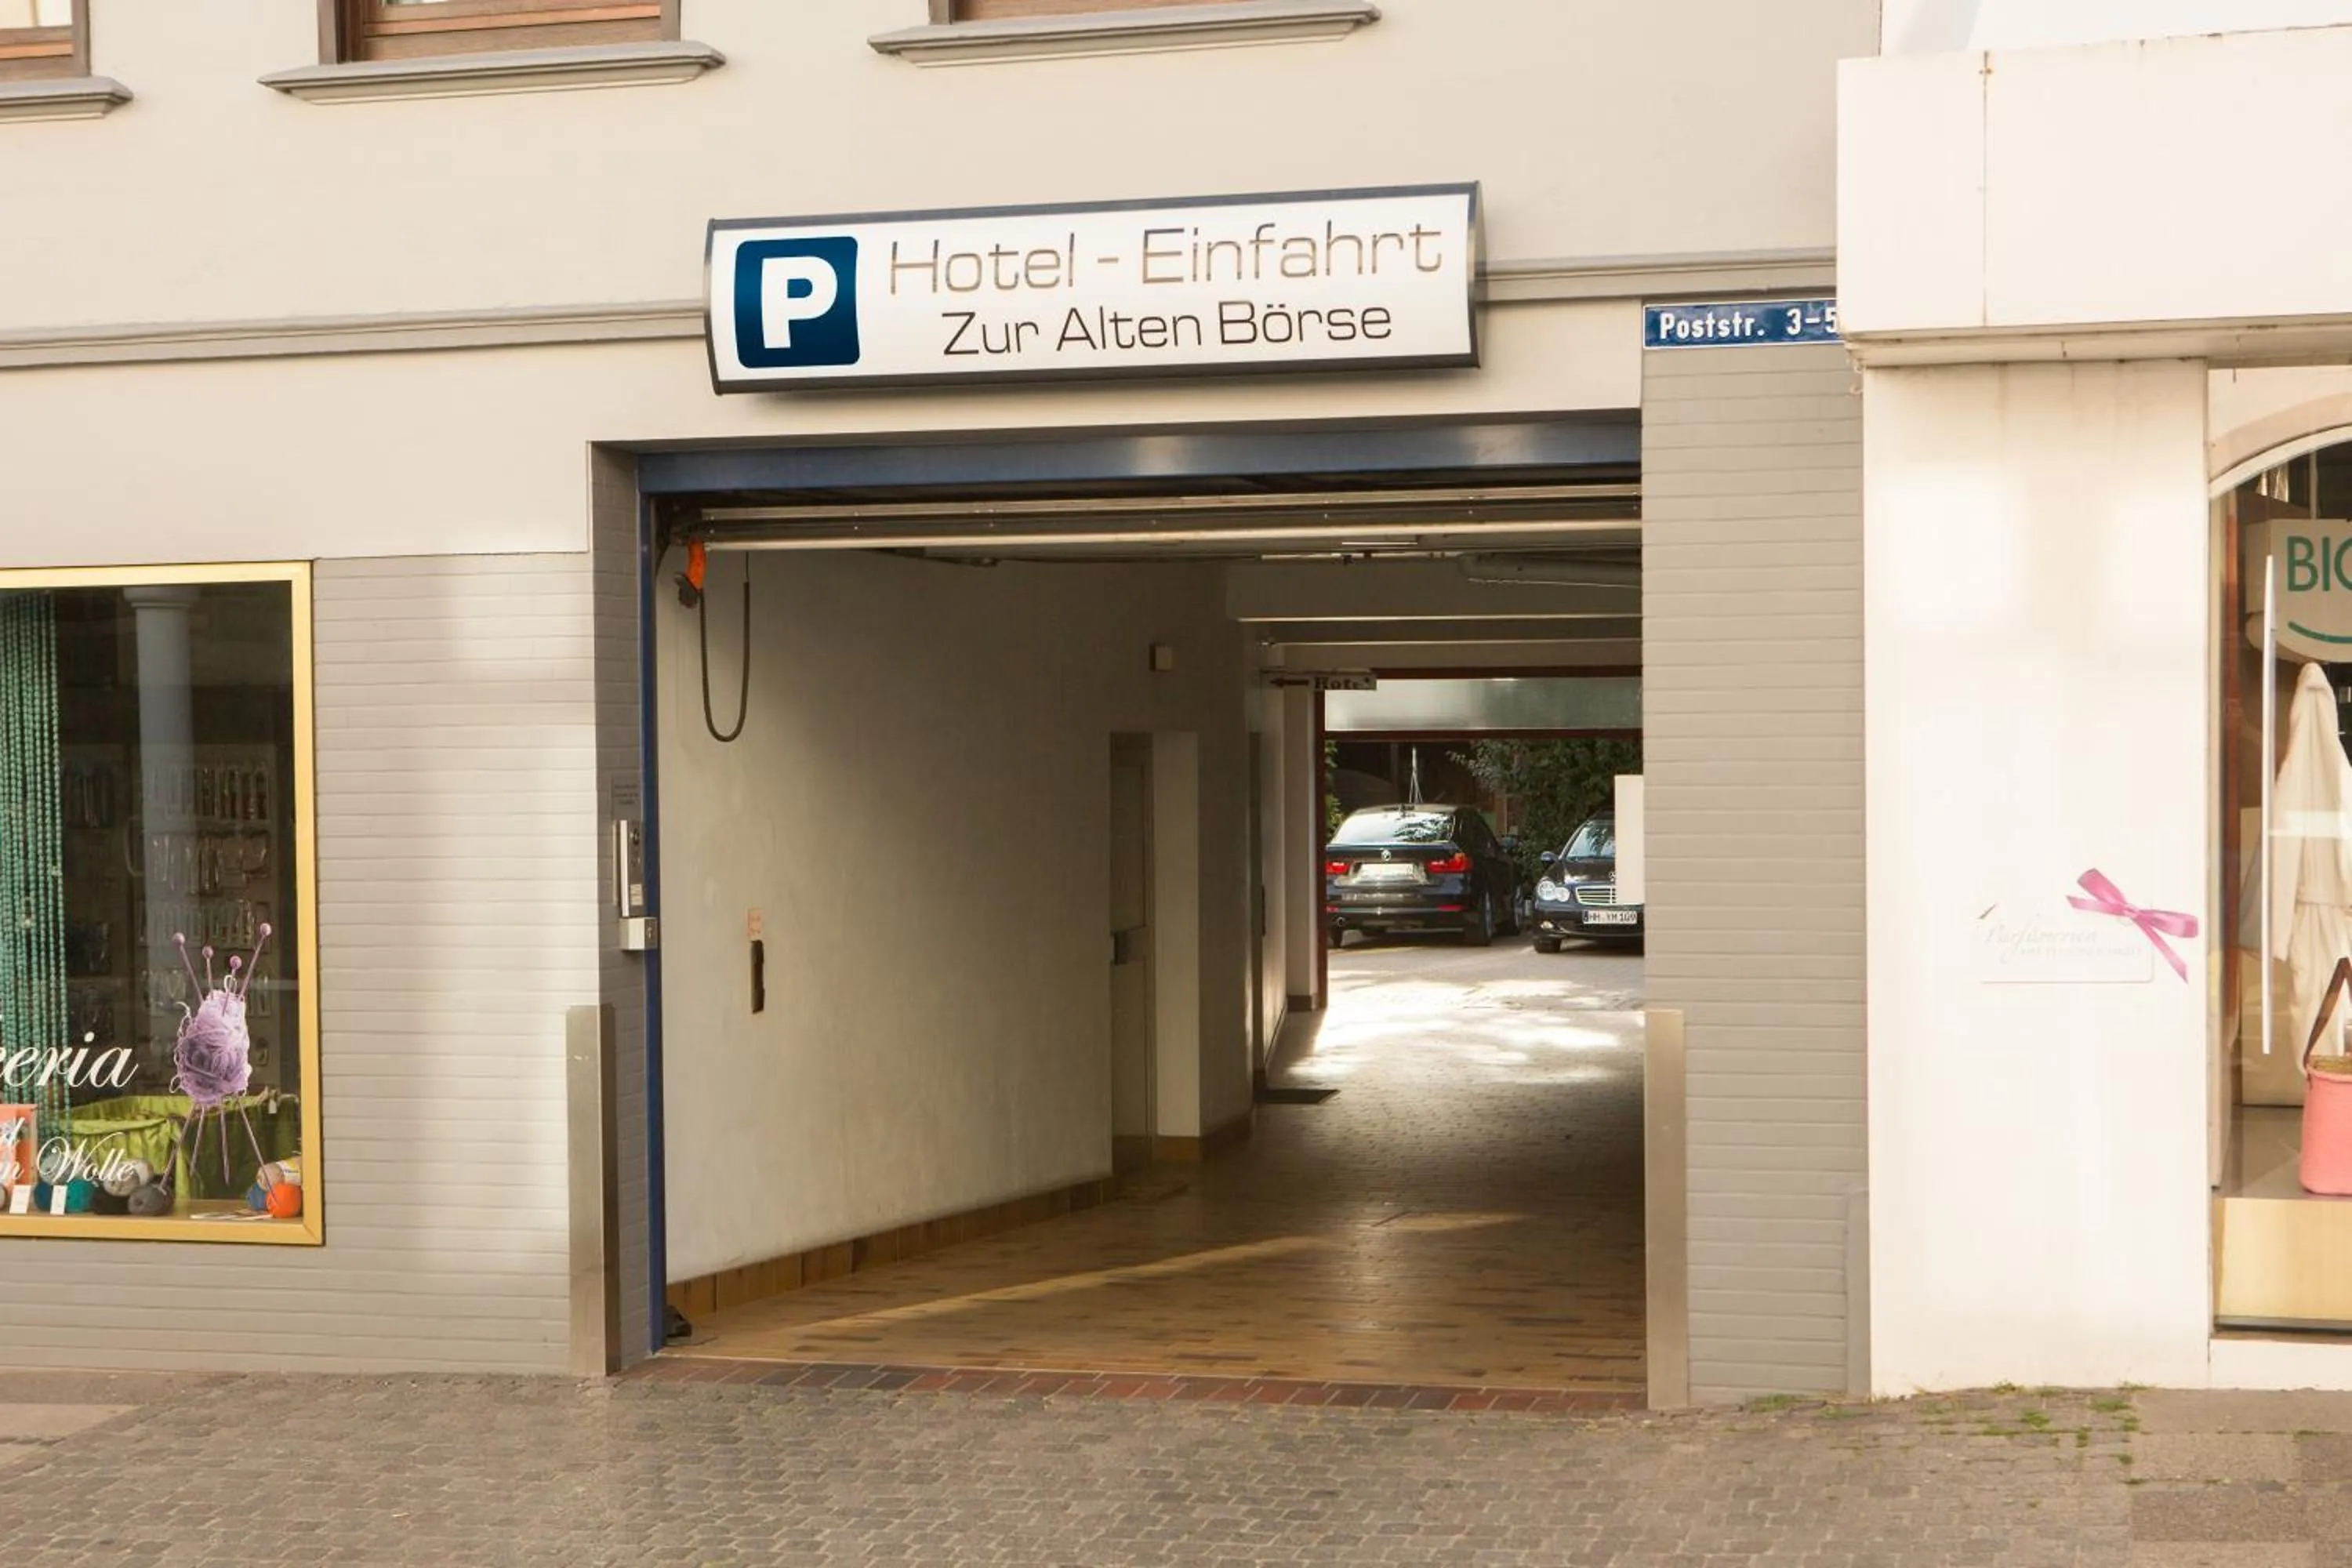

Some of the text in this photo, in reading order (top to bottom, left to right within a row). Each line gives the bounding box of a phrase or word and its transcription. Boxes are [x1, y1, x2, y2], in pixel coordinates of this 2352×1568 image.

[890, 232, 1076, 296] Hotel
[1142, 220, 1443, 285] Einfahrt
[760, 254, 838, 349] P
[941, 299, 1392, 357] Zur Alten Börse
[1659, 312, 1765, 339] Poststr.
[37, 1131, 135, 1182] Wolle
